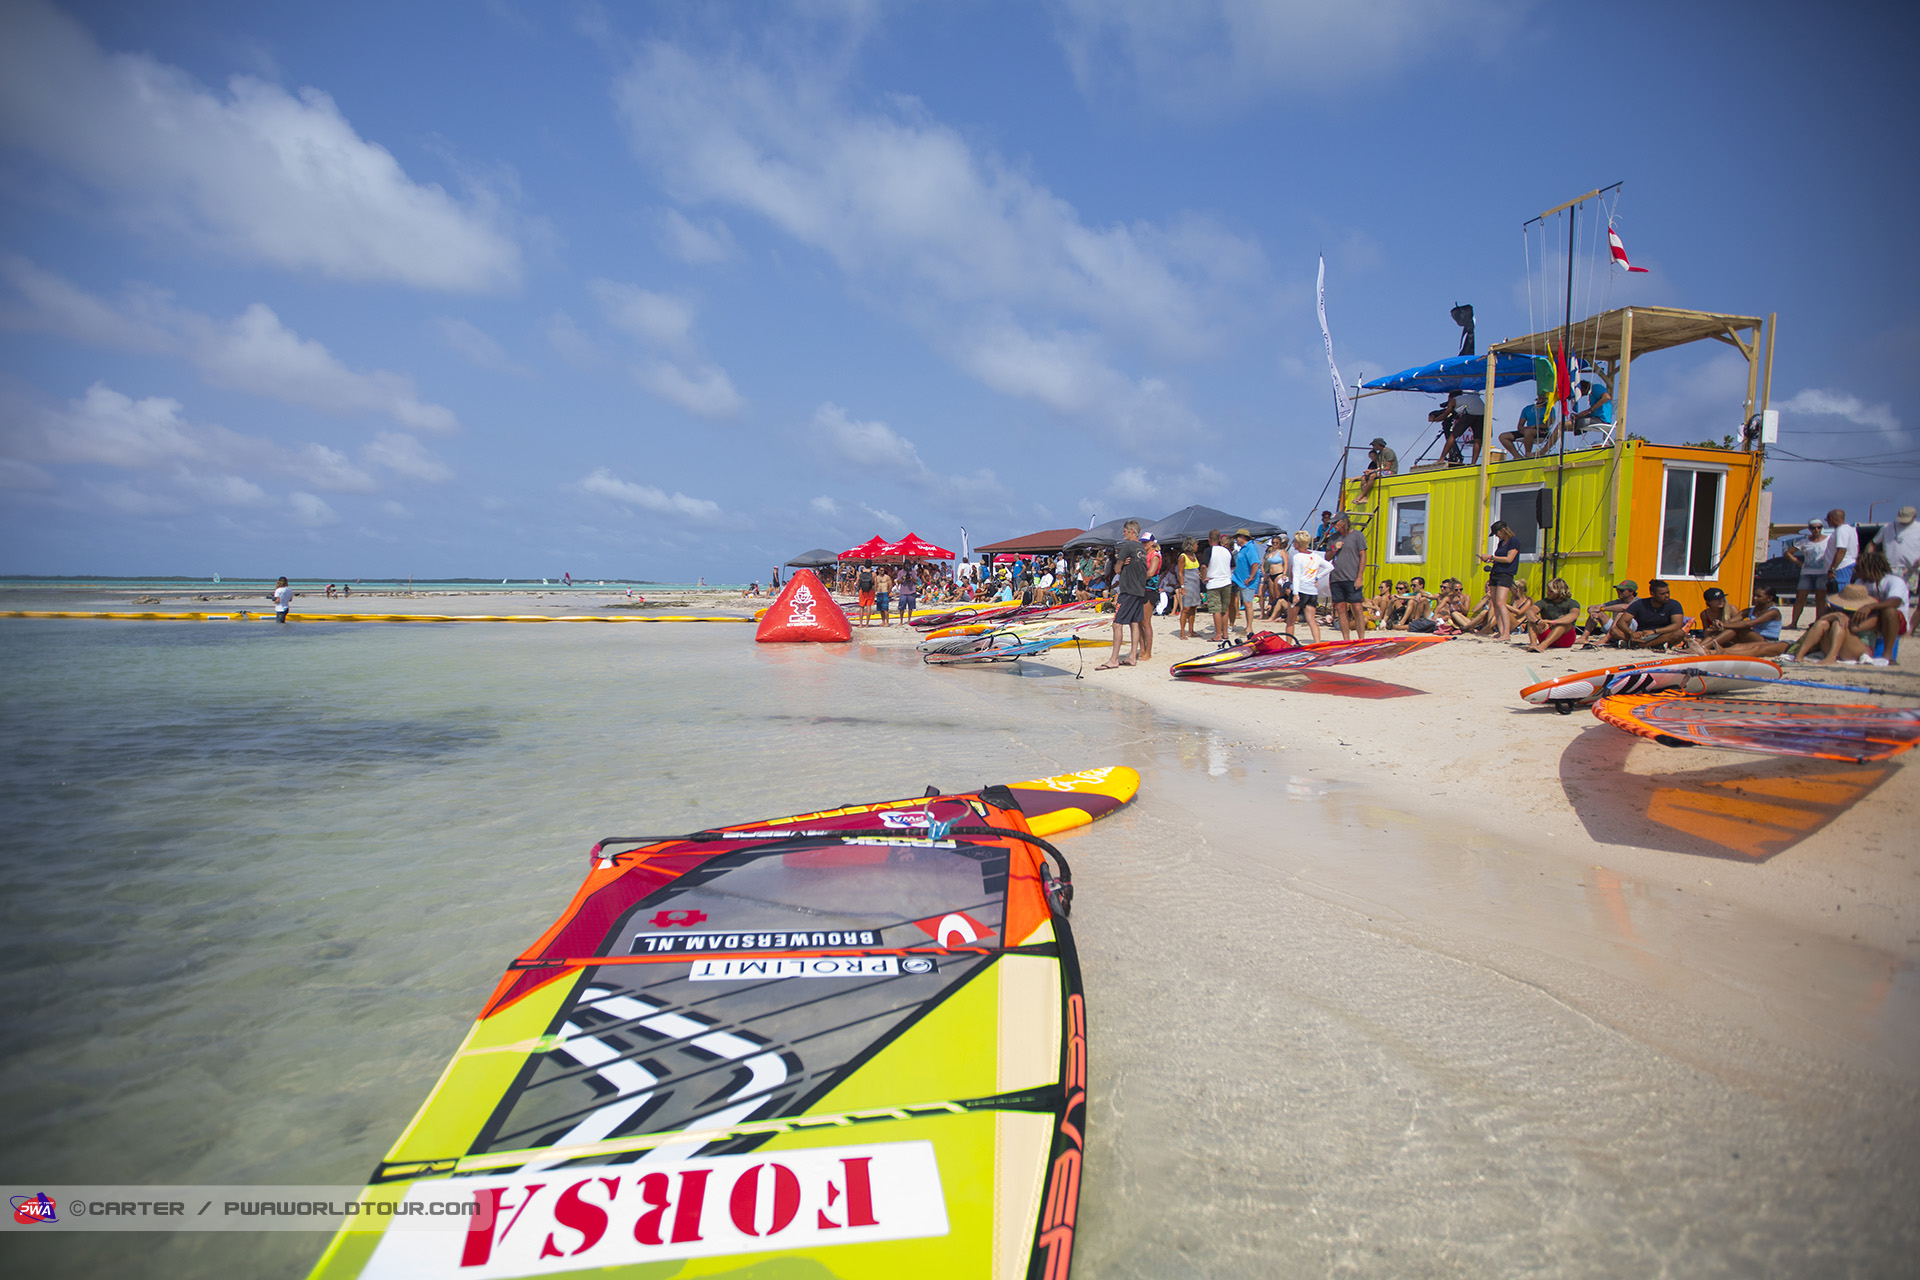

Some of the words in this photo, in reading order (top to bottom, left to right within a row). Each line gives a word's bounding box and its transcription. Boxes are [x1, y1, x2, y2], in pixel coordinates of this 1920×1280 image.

[892, 815, 925, 823] PWA
[644, 931, 874, 951] BROUWERSDAM.NL
[697, 960, 888, 977] PROLIMIT
[459, 1156, 880, 1268] FORSA
